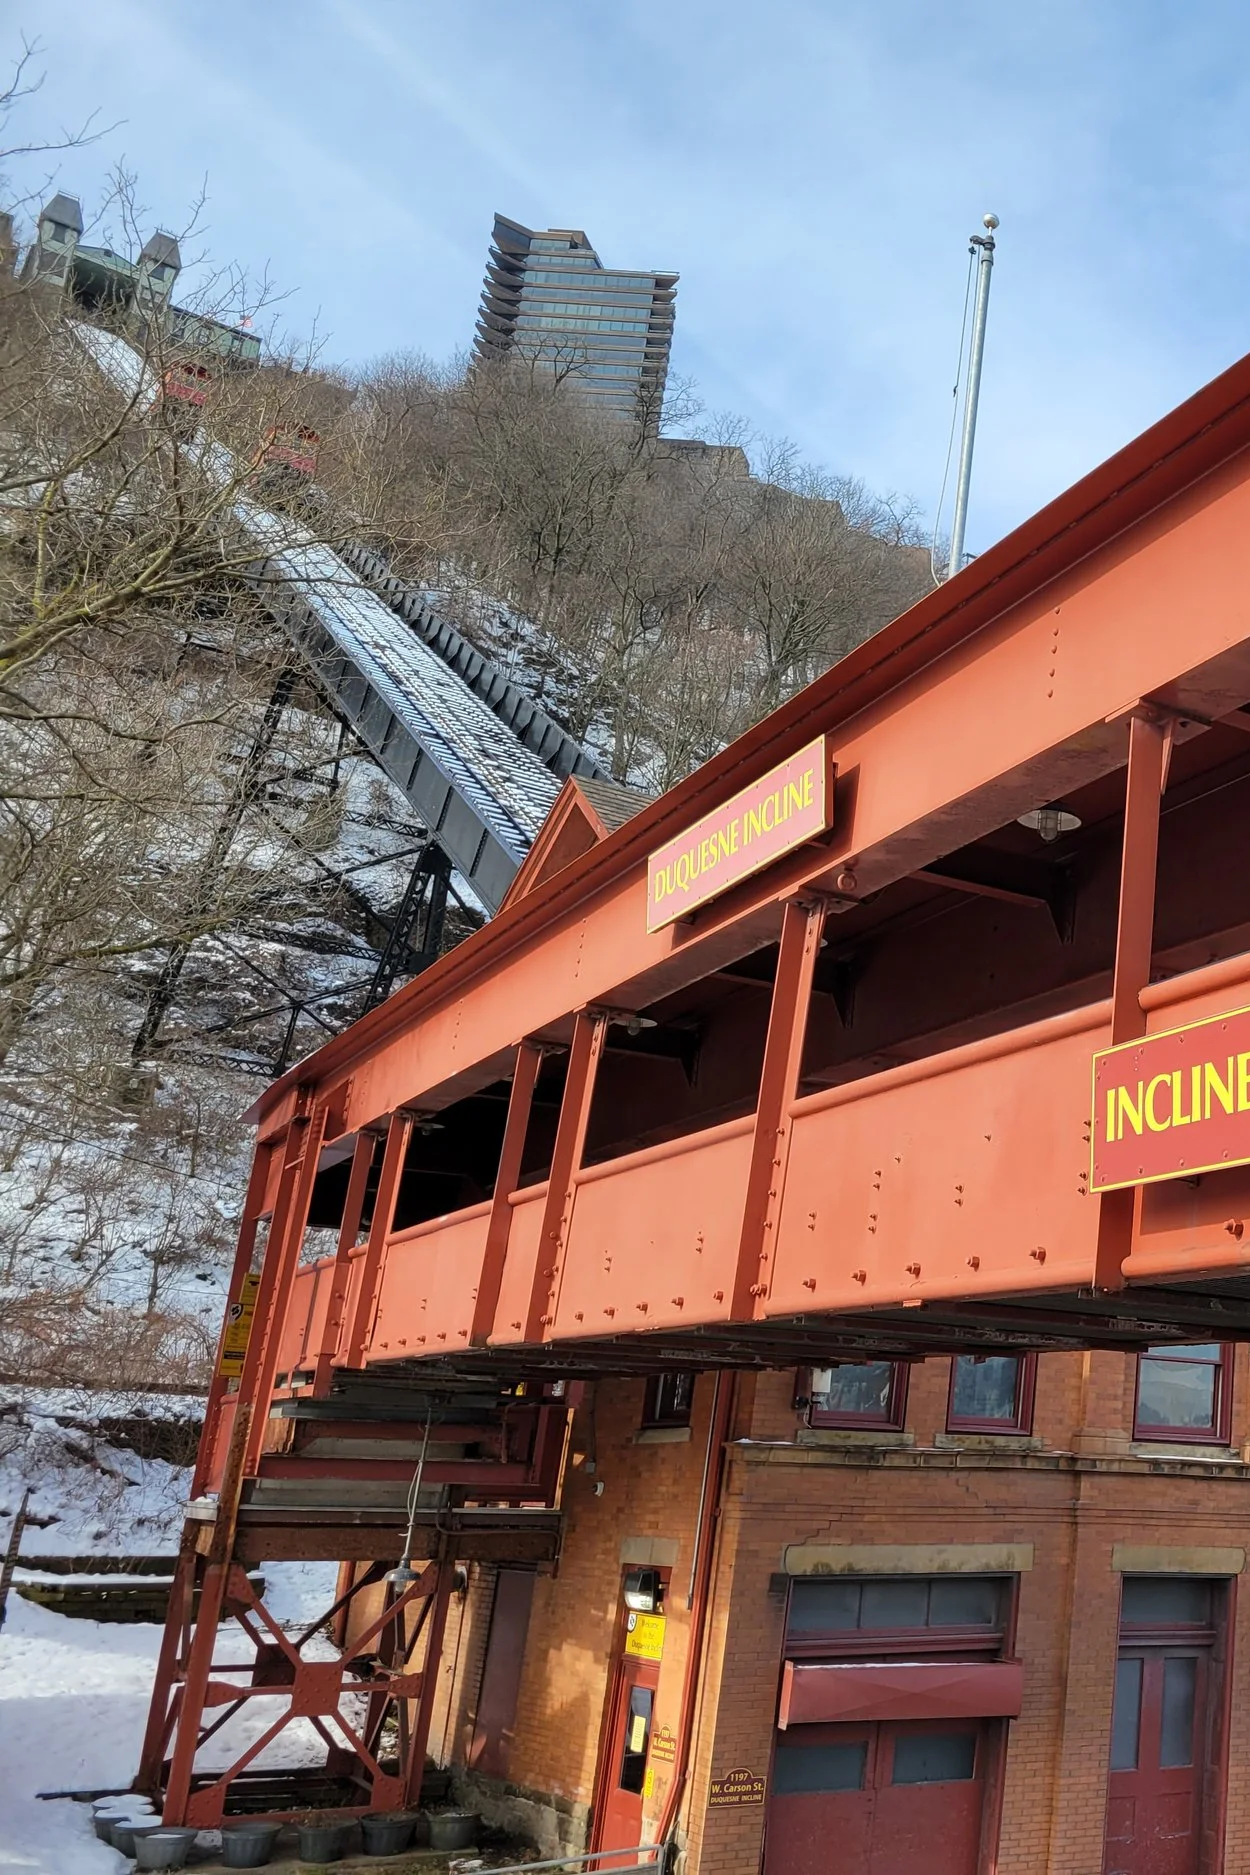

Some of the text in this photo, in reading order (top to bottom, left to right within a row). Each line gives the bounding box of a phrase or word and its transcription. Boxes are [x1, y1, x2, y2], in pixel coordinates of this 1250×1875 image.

[654, 768, 814, 904] DUQUESNE INCLINE
[730, 1773, 749, 1782] 1197
[711, 1781, 764, 1794] W. Carson St.
[710, 1795, 740, 1804] DUQUESNE
